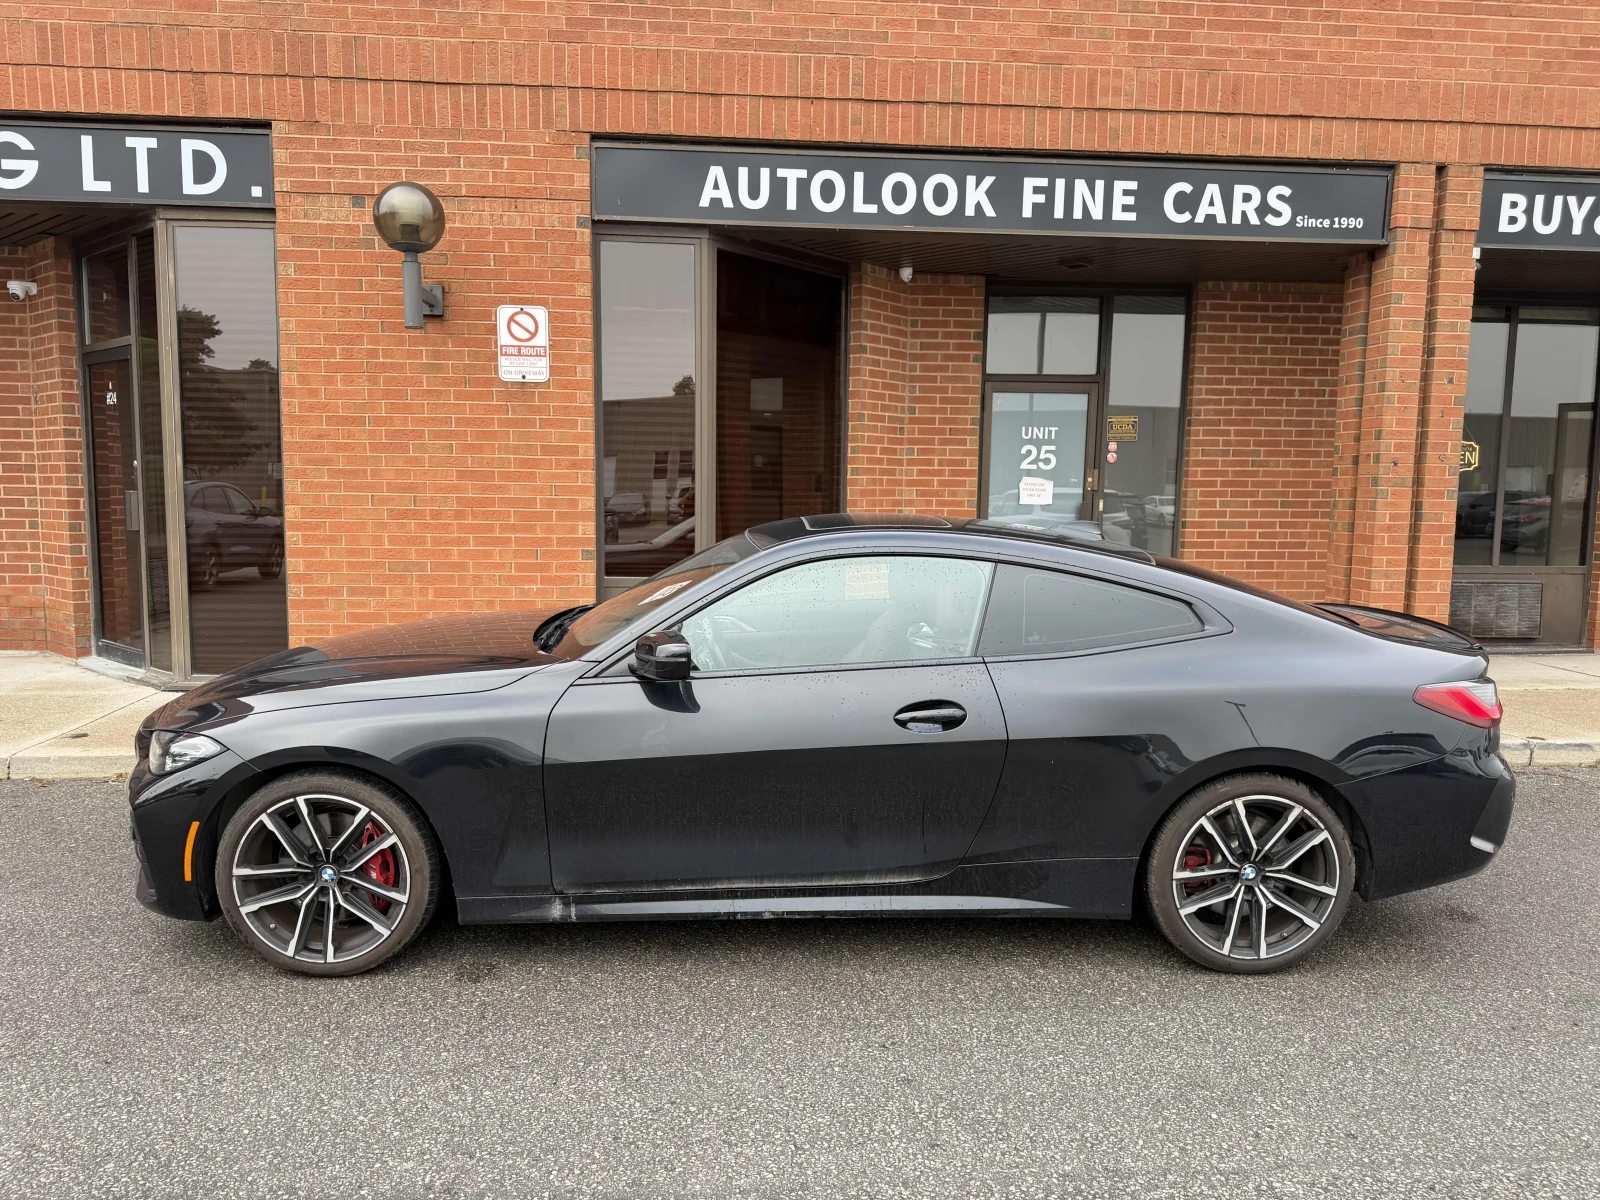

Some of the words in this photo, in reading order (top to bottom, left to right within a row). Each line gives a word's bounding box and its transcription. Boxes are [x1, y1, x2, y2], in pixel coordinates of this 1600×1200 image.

[698, 164, 997, 218] AUTOLOOK
[1021, 176, 1139, 222] FINE
[1162, 181, 1293, 227] CARS
[1295, 215, 1331, 229] Since
[1332, 216, 1364, 229] 1990
[502, 347, 519, 355] FIRE
[520, 347, 546, 355] ROUTE
[1021, 426, 1059, 440] UNIT
[1019, 444, 1057, 470] 25
[306, 782, 362, 797] BRIDGESTONE
